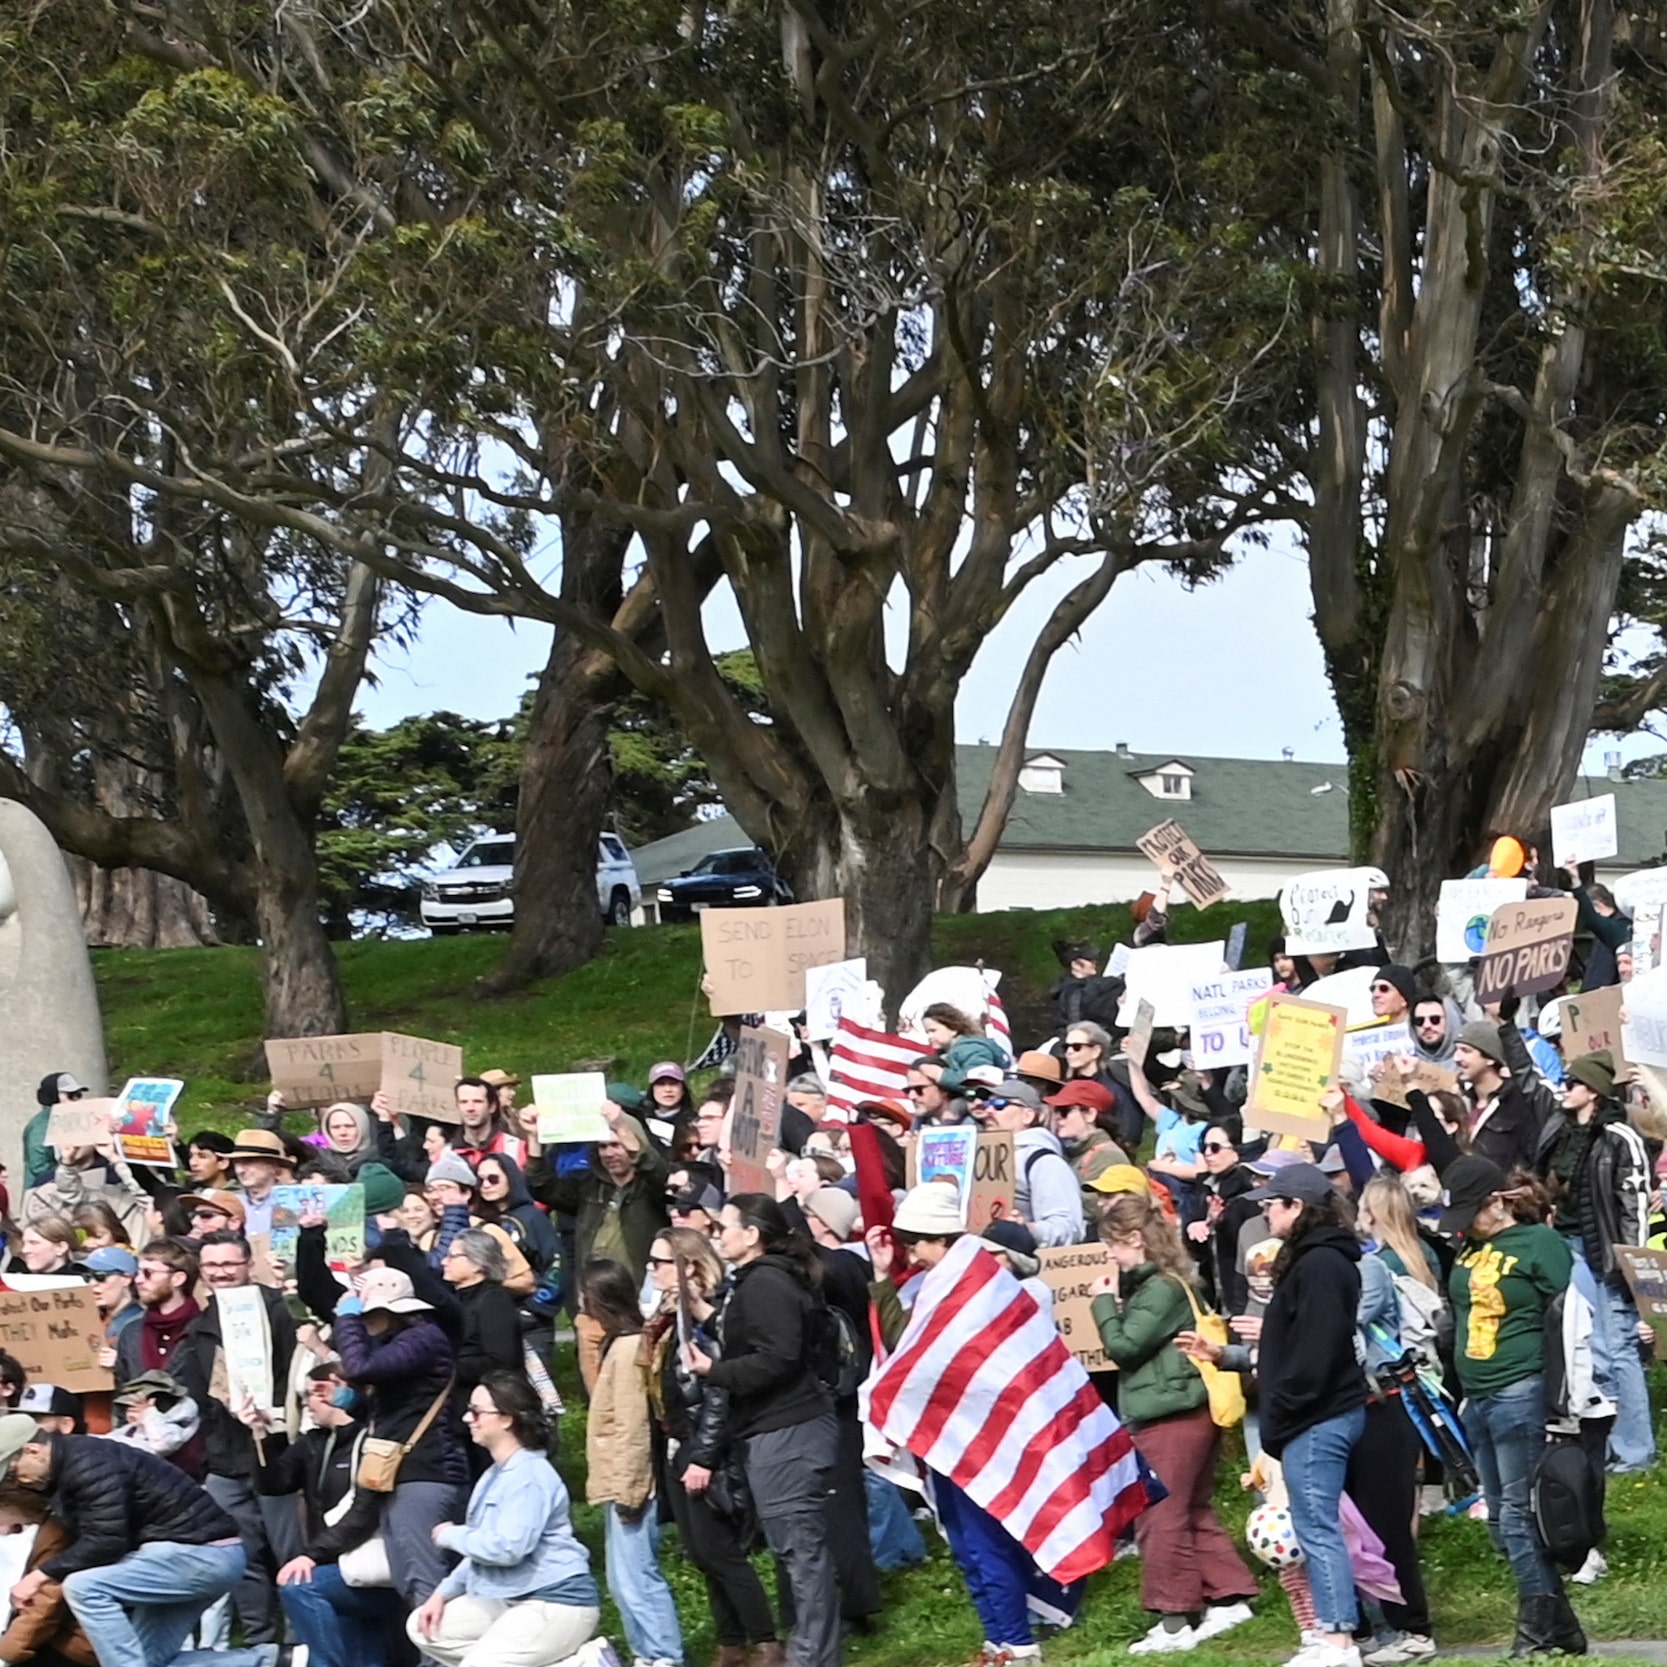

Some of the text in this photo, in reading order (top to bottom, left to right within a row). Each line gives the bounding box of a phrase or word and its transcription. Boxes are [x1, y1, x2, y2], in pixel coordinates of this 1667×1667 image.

[1141, 820, 1187, 858] PROTECT
[1173, 857, 1229, 904] PARKS
[718, 917, 829, 943] SEND ELON
[726, 958, 753, 981] TO
[1478, 940, 1569, 996] NO PARKS
[1232, 976, 1268, 993] PARKS
[287, 1038, 361, 1062] PARKS
[1200, 1031, 1225, 1054] TO
[319, 1063, 334, 1082] 4
[408, 1062, 426, 1092] 4
[973, 1143, 1009, 1183] OUR
[1044, 1251, 1108, 1271] ANGEROUS
